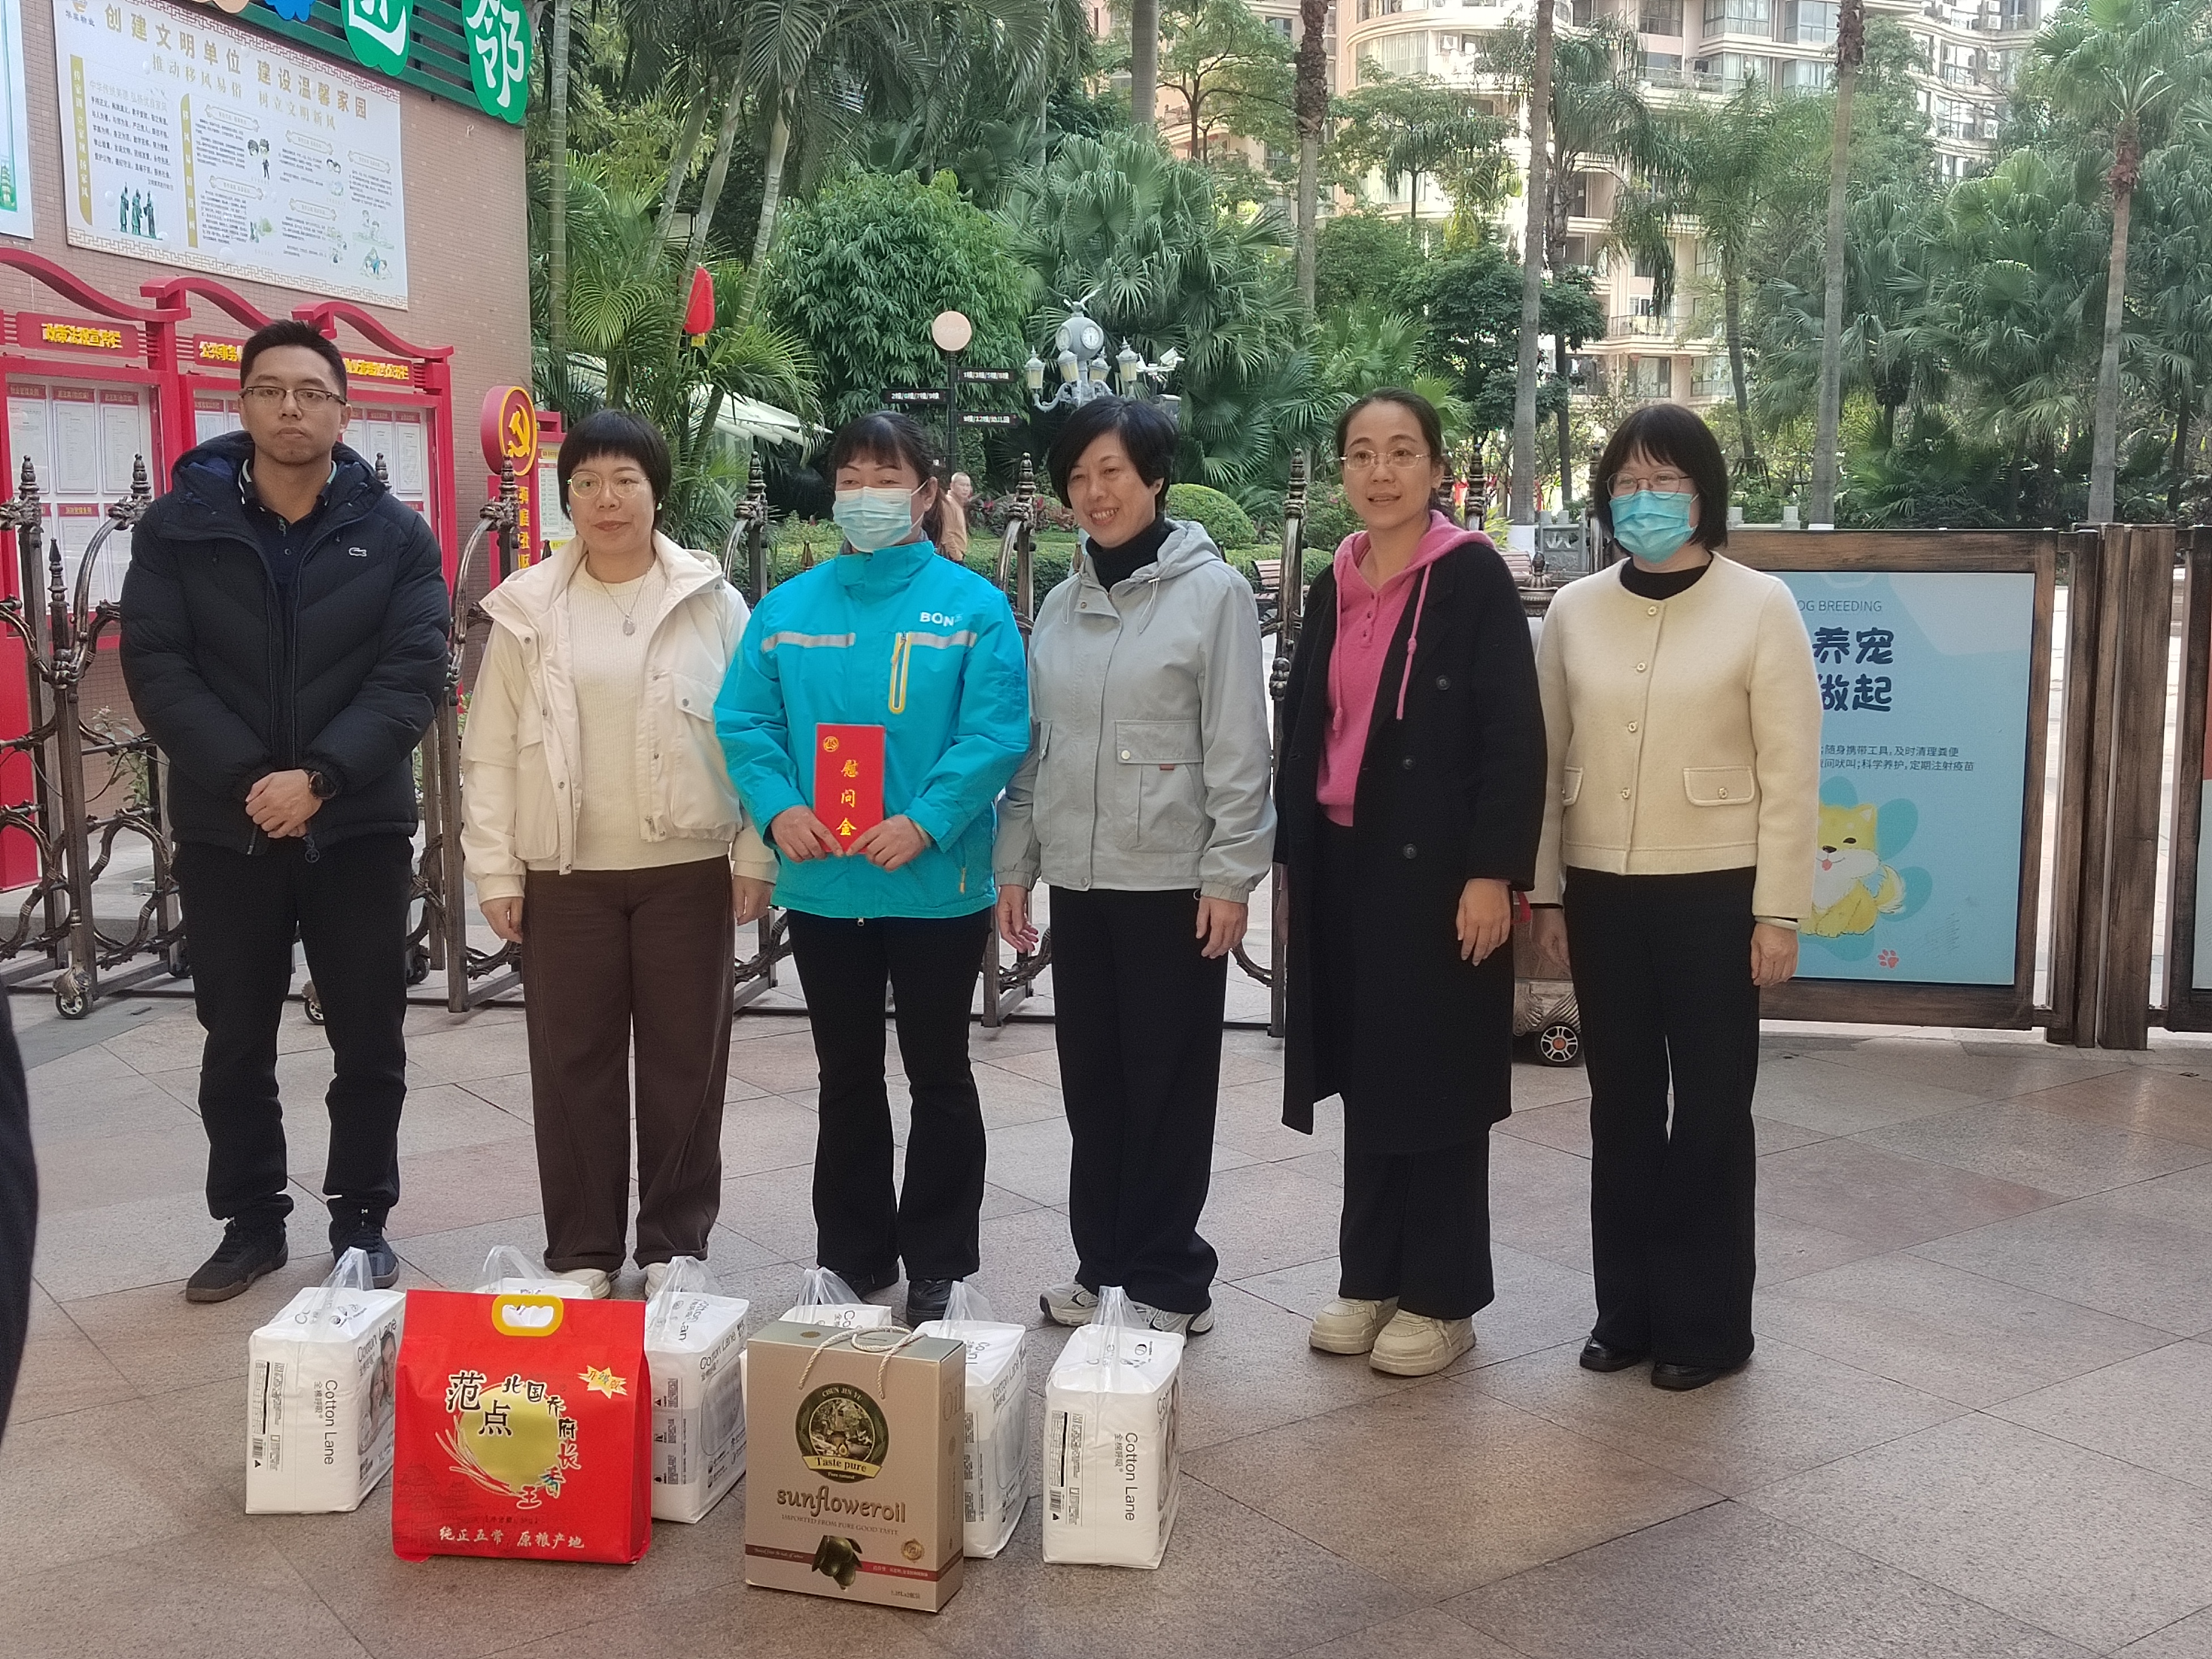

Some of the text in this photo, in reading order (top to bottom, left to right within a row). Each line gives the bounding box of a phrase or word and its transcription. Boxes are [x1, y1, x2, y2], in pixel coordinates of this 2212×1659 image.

[105, 3, 367, 120] 创建文明单位 建设温馨家园
[152, 53, 335, 131] 推动移风易俗 树立文明新风
[1818, 600, 1882, 612] BREEDING
[1812, 627, 1894, 664] 养宠
[836, 759, 860, 836] 慰问金
[324, 1380, 338, 1465] Cotton Lane
[815, 1457, 866, 1473] Taste pure
[1125, 1432, 1138, 1521] Cotton Lane
[776, 1484, 906, 1524] sunfloweroil
[440, 1526, 584, 1550] 纯正五常 原粮产地
[781, 1513, 898, 1537] IMPORTED FROM PURE GOOD TASTE
